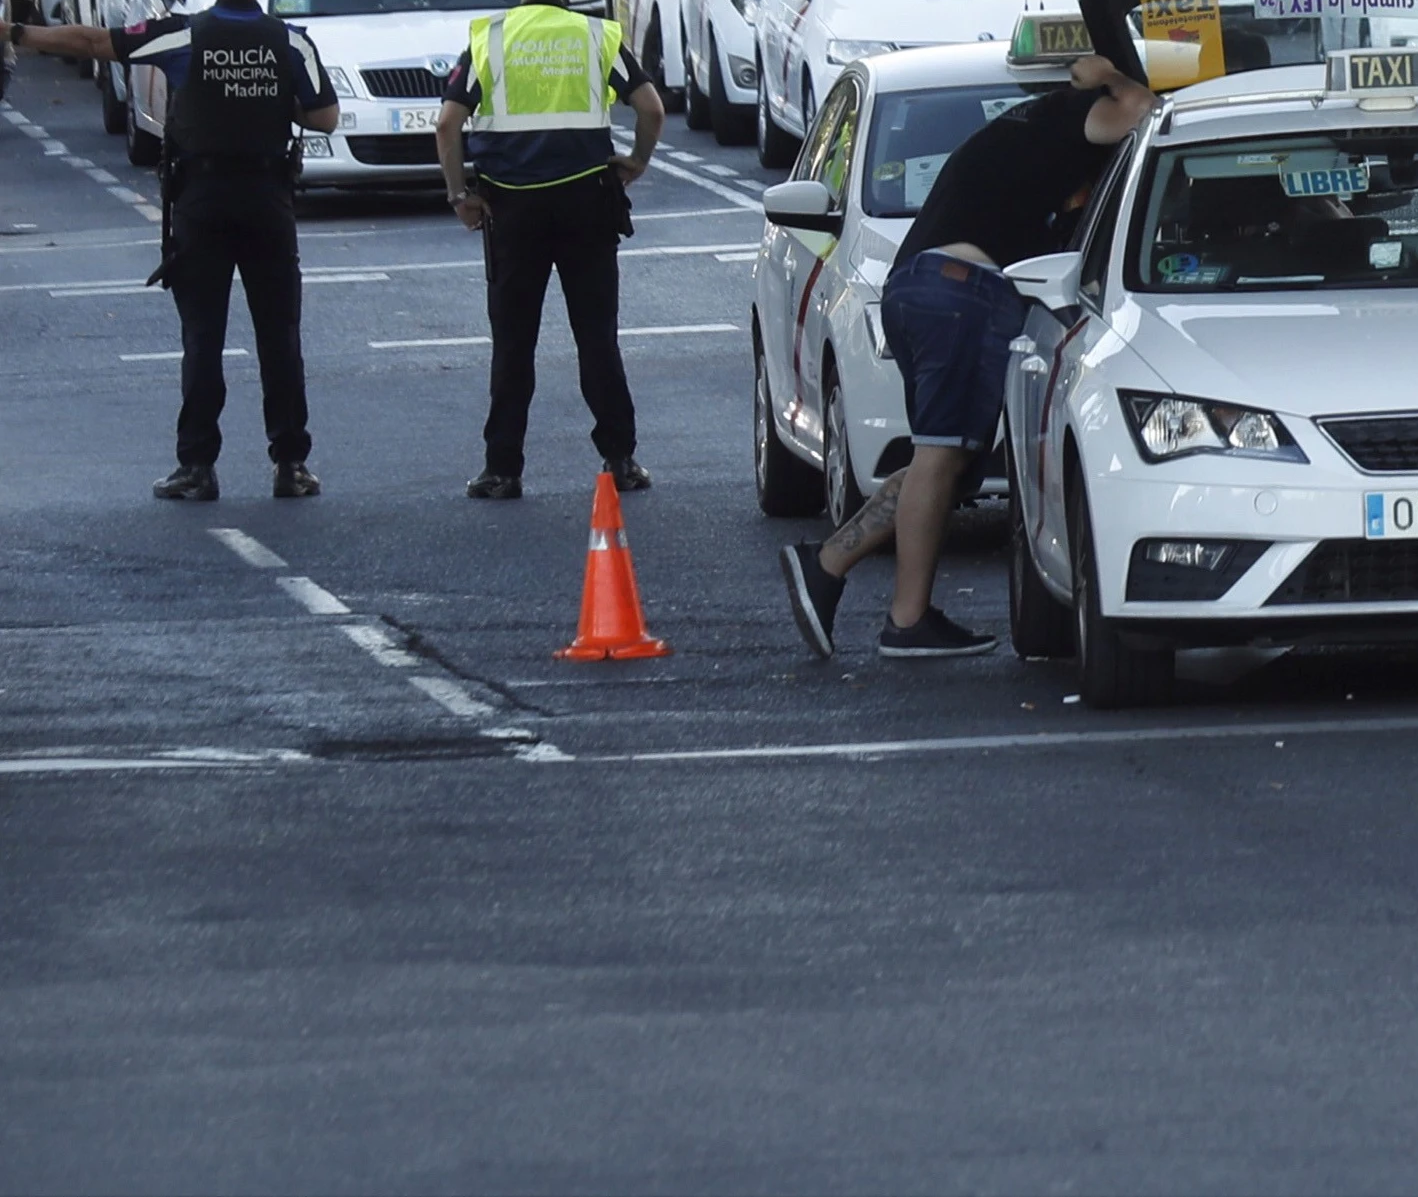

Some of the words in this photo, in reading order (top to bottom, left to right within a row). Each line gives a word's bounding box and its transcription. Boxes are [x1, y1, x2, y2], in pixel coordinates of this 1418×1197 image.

[203, 45, 277, 66] POLICÍA
[511, 55, 581, 66] MUNICIPAL
[203, 67, 278, 80] MUNICIPAL
[542, 66, 584, 76] Madrid
[1352, 56, 1412, 86] TAXI
[225, 82, 278, 97] Madrid
[1286, 168, 1366, 195] LIBRE
